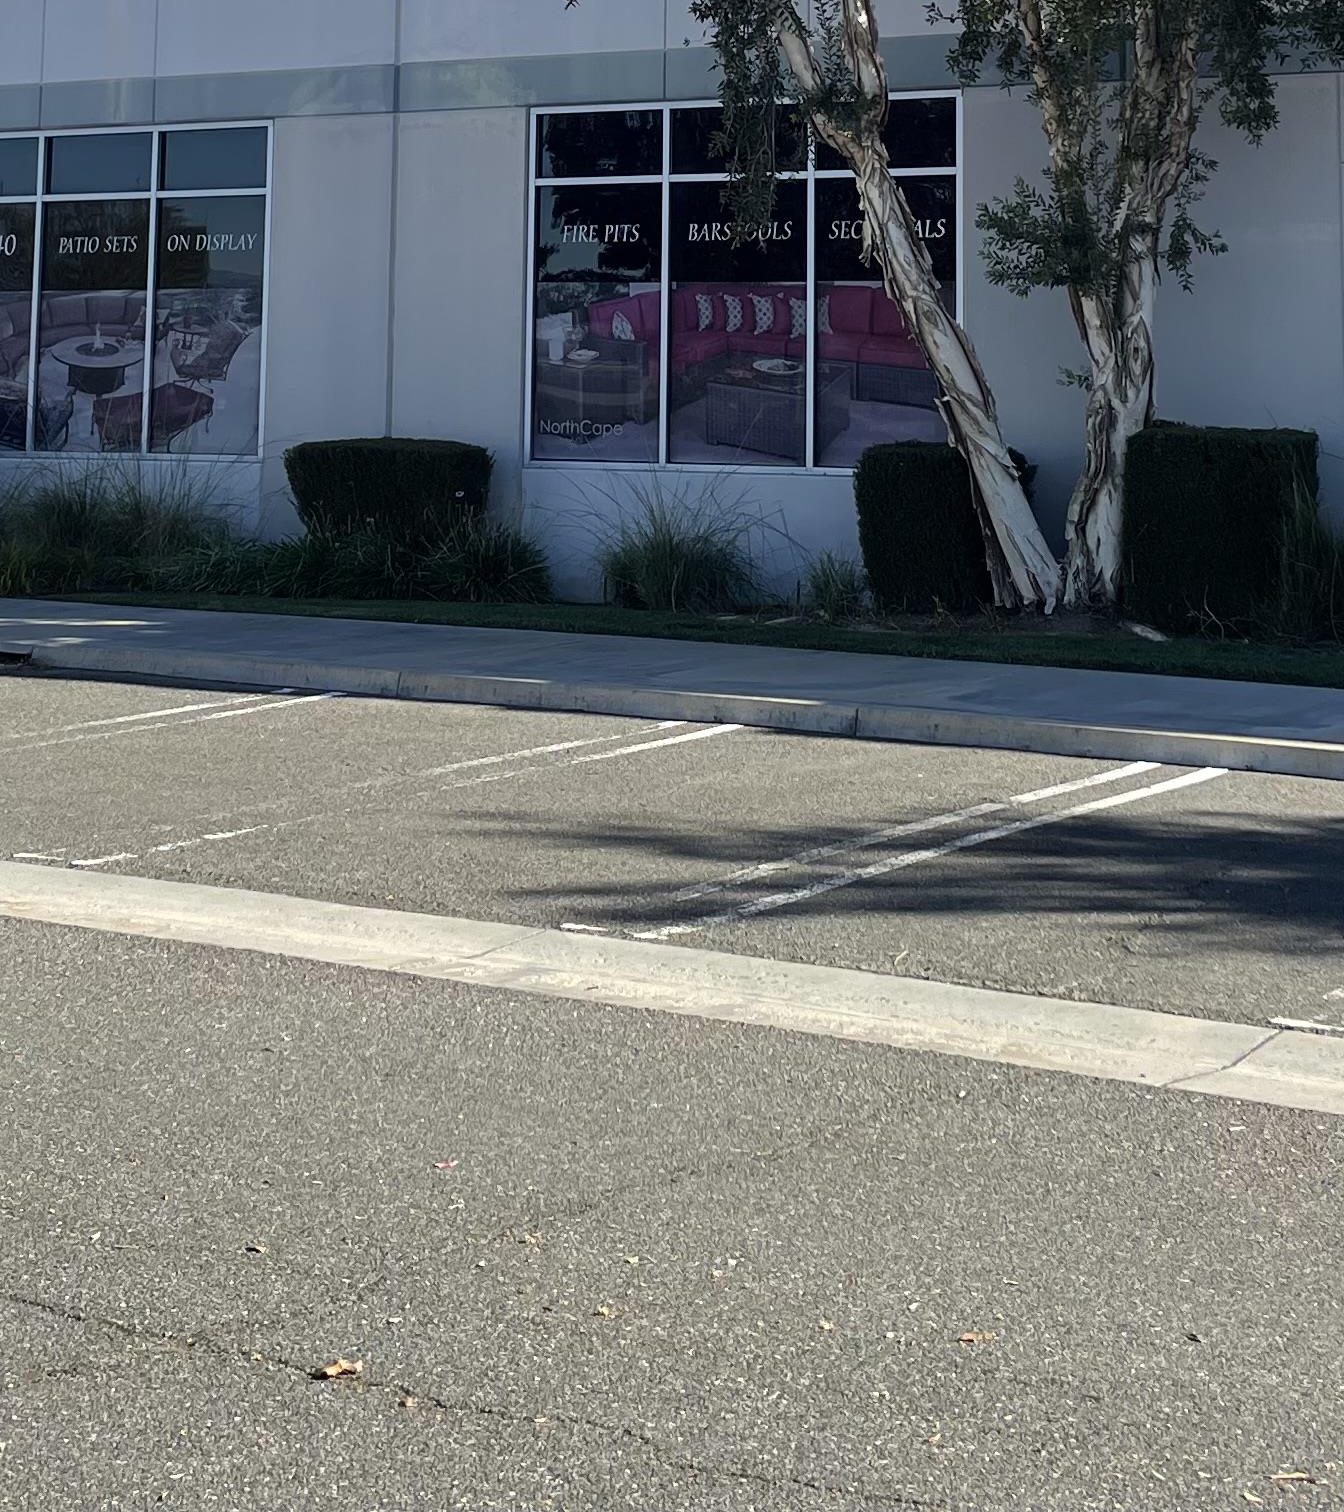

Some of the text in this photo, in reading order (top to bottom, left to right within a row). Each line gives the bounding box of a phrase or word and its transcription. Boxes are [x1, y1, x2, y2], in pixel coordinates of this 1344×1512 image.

[562, 223, 640, 243] FIRE PITS
[828, 218, 947, 240] SECALS
[59, 235, 138, 254] PATIO SETS
[167, 232, 258, 252] ON DISPLAY
[539, 419, 624, 438] NorthCape
